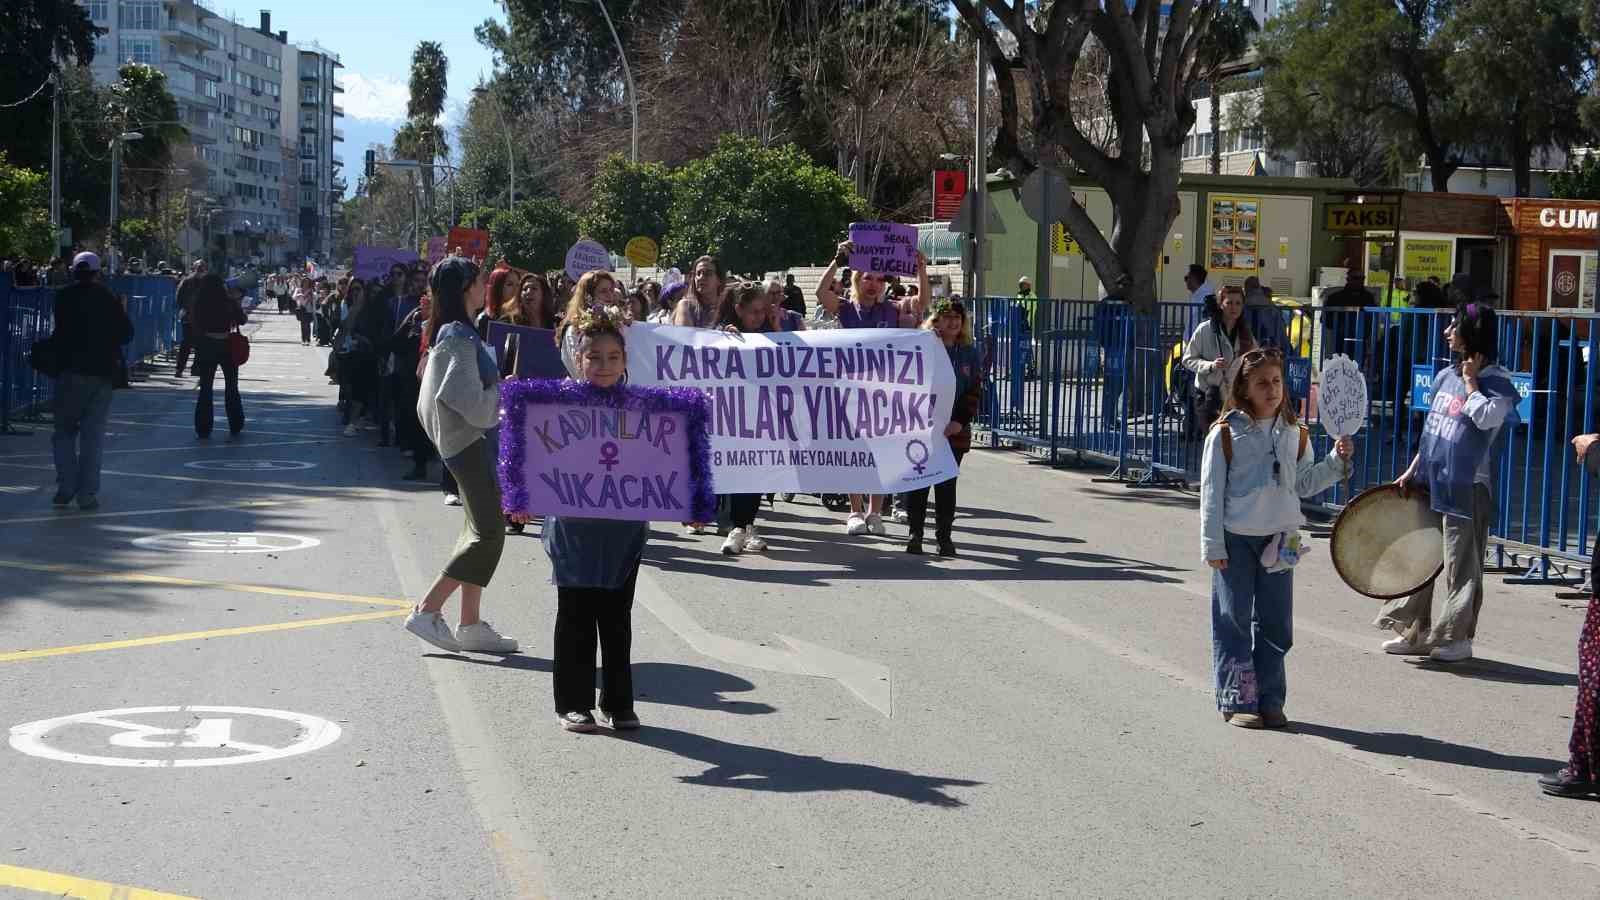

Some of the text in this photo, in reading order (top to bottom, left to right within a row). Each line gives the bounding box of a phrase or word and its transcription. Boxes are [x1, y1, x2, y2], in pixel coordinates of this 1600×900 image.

[656, 342, 925, 385] KARA DÜZENİNİZİ
[533, 408, 676, 456] KADINLAR
[706, 384, 937, 441] INLAR YIKACAK!
[714, 450, 877, 468] 8 MART'TA MEYDANLARA
[539, 467, 684, 511] YIKACAK
